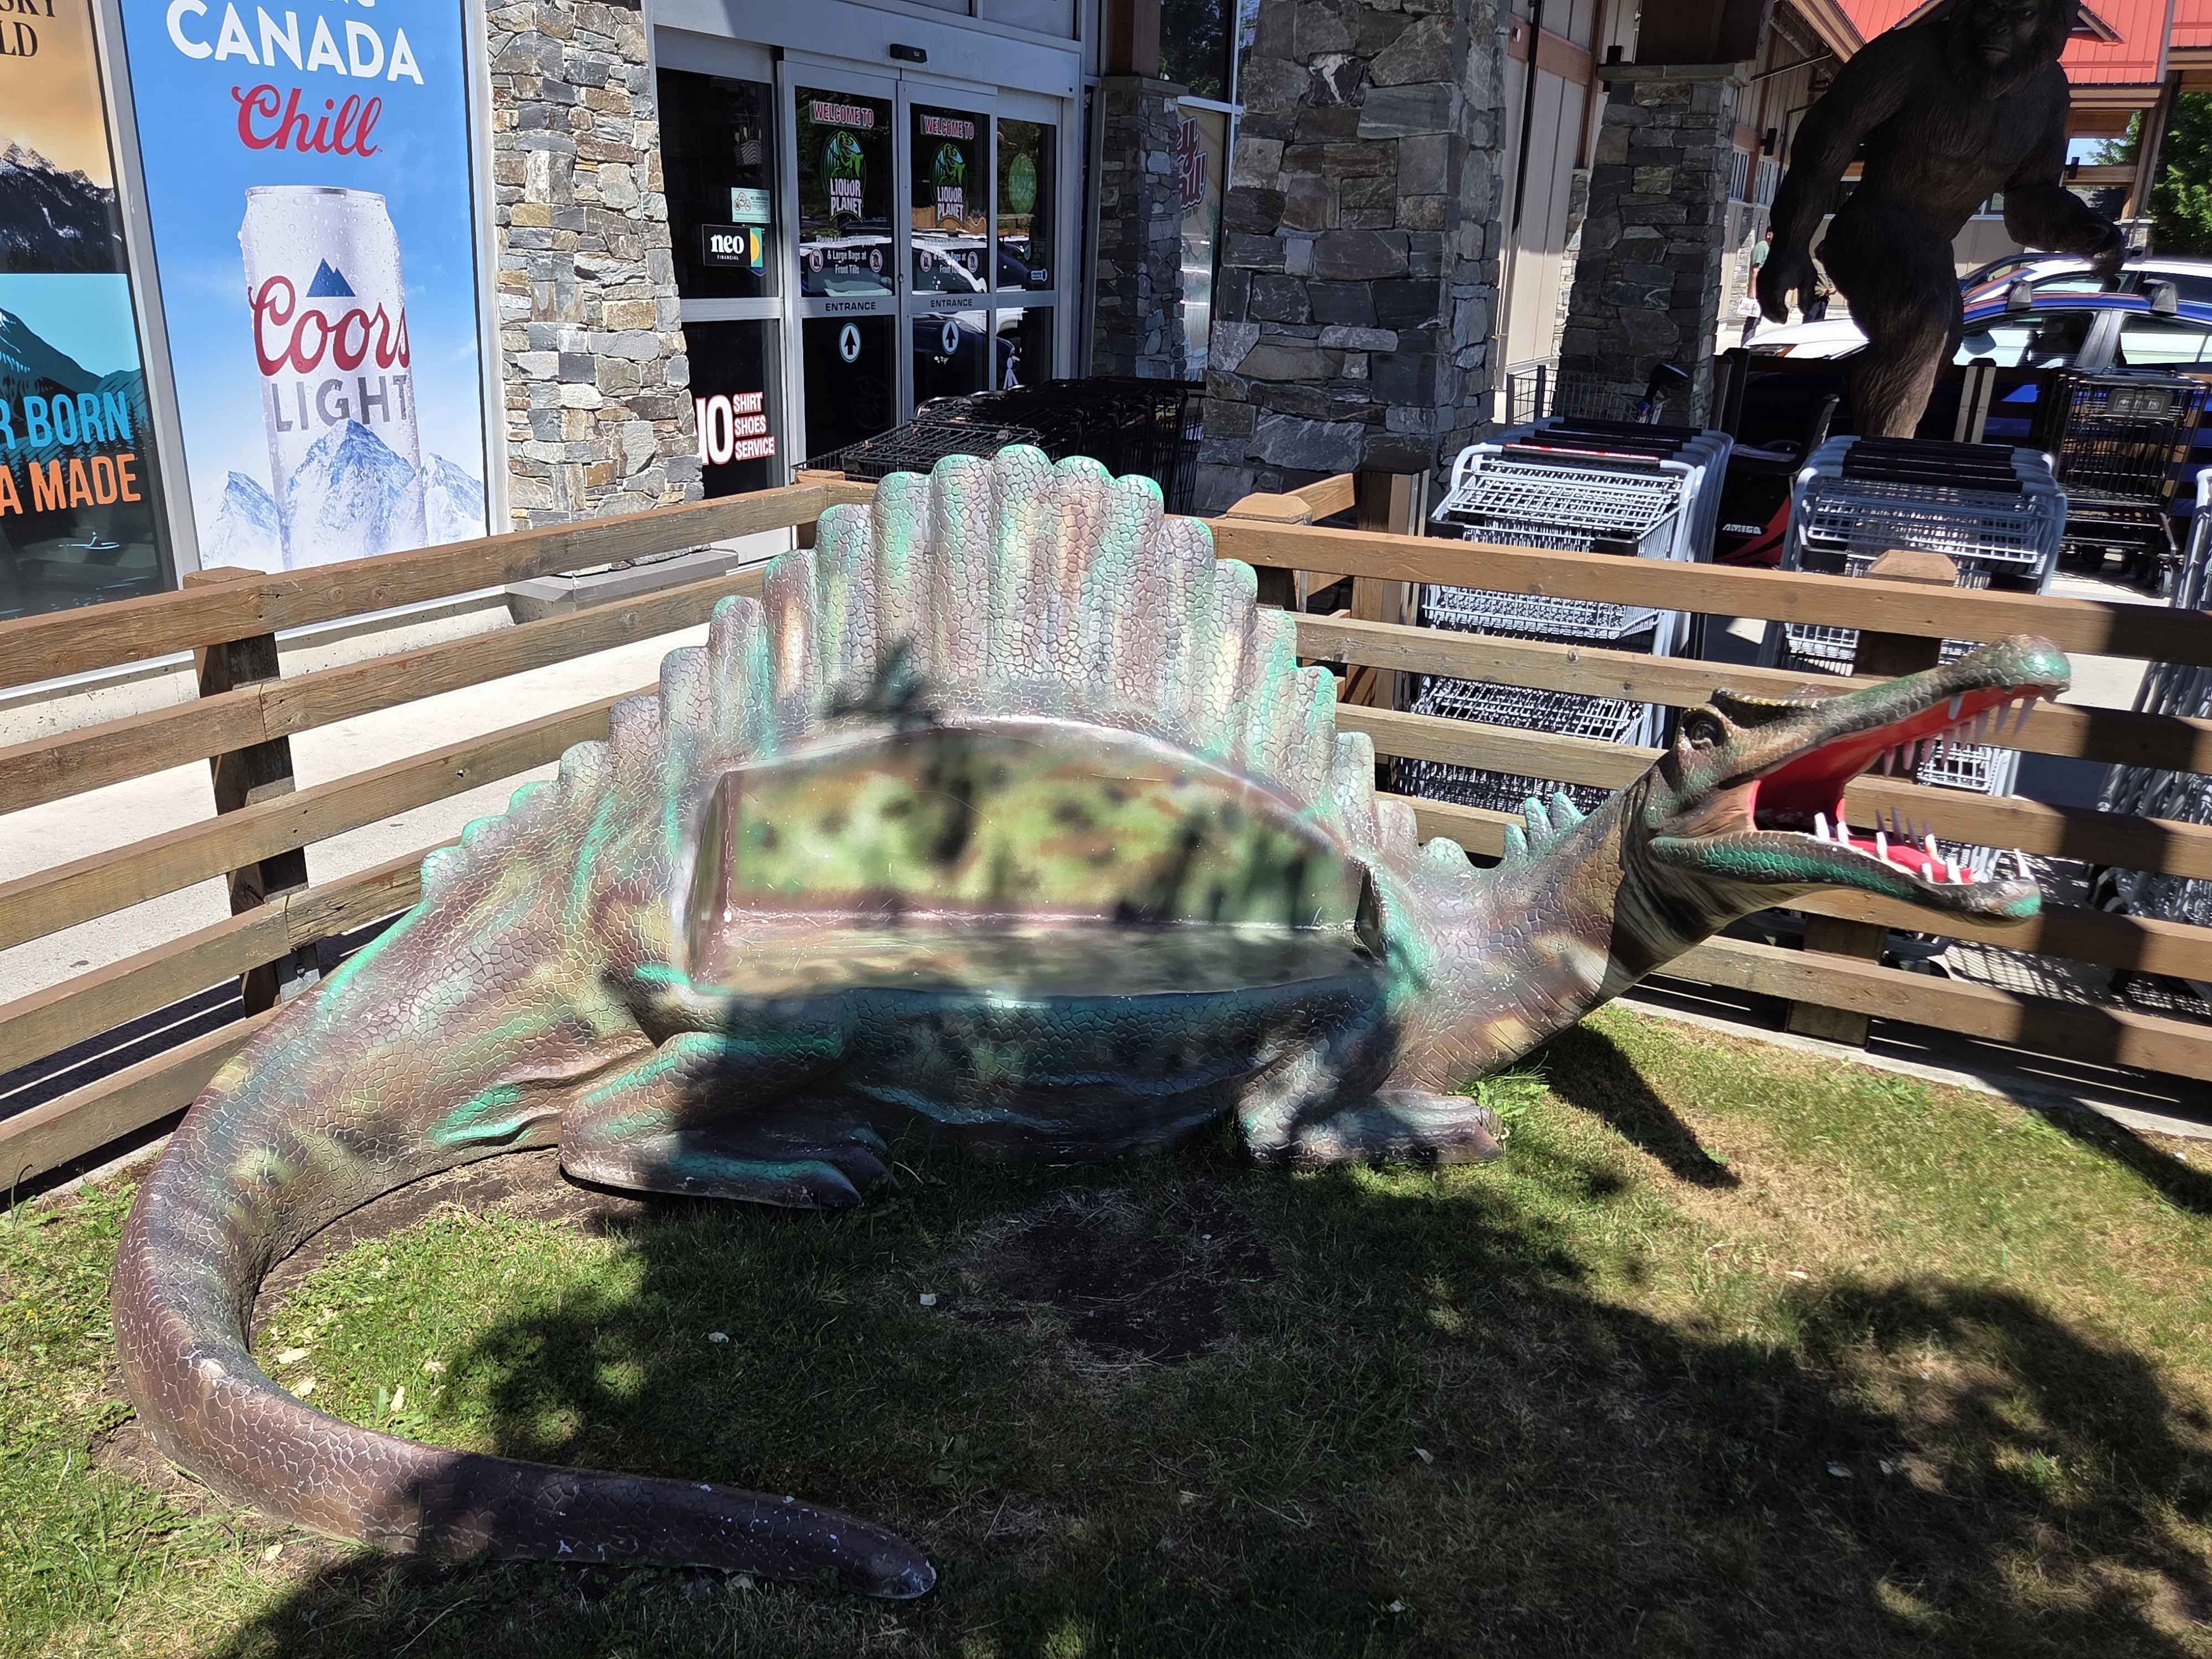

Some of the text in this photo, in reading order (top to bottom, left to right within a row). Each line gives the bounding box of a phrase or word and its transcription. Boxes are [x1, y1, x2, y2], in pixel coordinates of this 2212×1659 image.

[166, 0, 425, 85] CANADA
[231, 84, 382, 157] Chill
[813, 101, 874, 128] WELCOME TO
[924, 116, 975, 139] WELCOME TO
[830, 178, 861, 197] LIQUOR
[937, 186, 963, 204] LIQUOR
[831, 196, 862, 219] PLANET
[937, 202, 964, 222] PLANET
[710, 234, 744, 254] neo
[827, 250, 832, 260] &
[833, 250, 847, 262] Large
[848, 250, 860, 262] Bags
[835, 264, 848, 274] Front
[825, 302, 877, 311] ENTRANCE
[931, 299, 973, 307] ENTRANCE
[248, 275, 410, 377] Coors
[271, 375, 408, 432] LIGHT
[733, 392, 763, 414] SHIRT
[23, 391, 131, 447] BORN
[734, 414, 767, 437] SHOES
[735, 436, 775, 461] SERVICE
[29, 453, 141, 512] MADE
